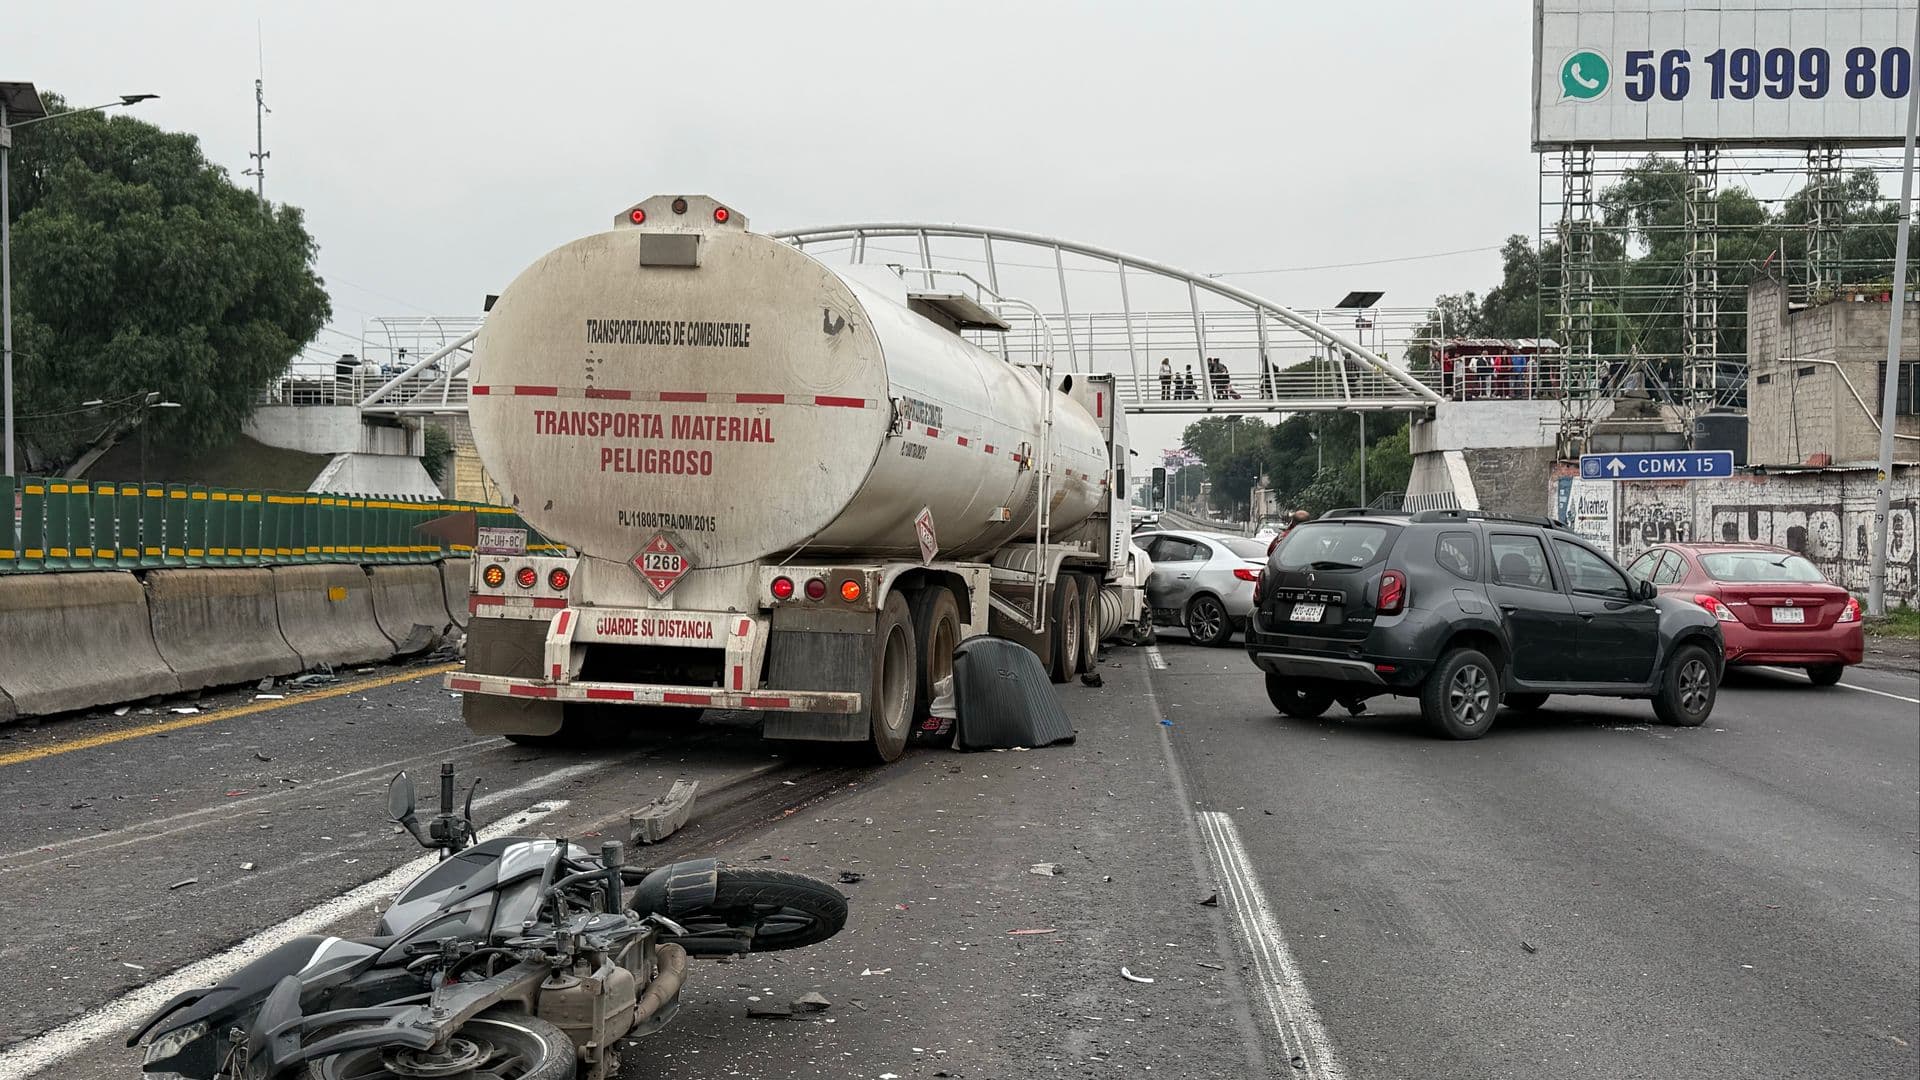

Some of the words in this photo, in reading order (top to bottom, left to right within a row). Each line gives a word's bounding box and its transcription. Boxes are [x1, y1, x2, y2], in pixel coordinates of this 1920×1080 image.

[1625, 49, 1691, 101] 56
[1703, 47, 1830, 100] 1999
[1844, 46, 1911, 99] 80
[586, 319, 671, 345] TRANSPORTADORES
[673, 321, 686, 346] DE
[687, 322, 751, 348] COMBUSTIBLE
[534, 410, 664, 439] TRANSPORTA
[671, 414, 775, 443] MATERIAL
[600, 447, 713, 476] PELIGROSO
[1638, 458, 1687, 474] CDMX
[1696, 457, 1714, 472] 15
[644, 554, 680, 571] 1268
[658, 579, 666, 588] 3
[596, 617, 639, 636] GUARDE
[641, 618, 655, 637] SU
[658, 619, 713, 639] DISTANCIA
